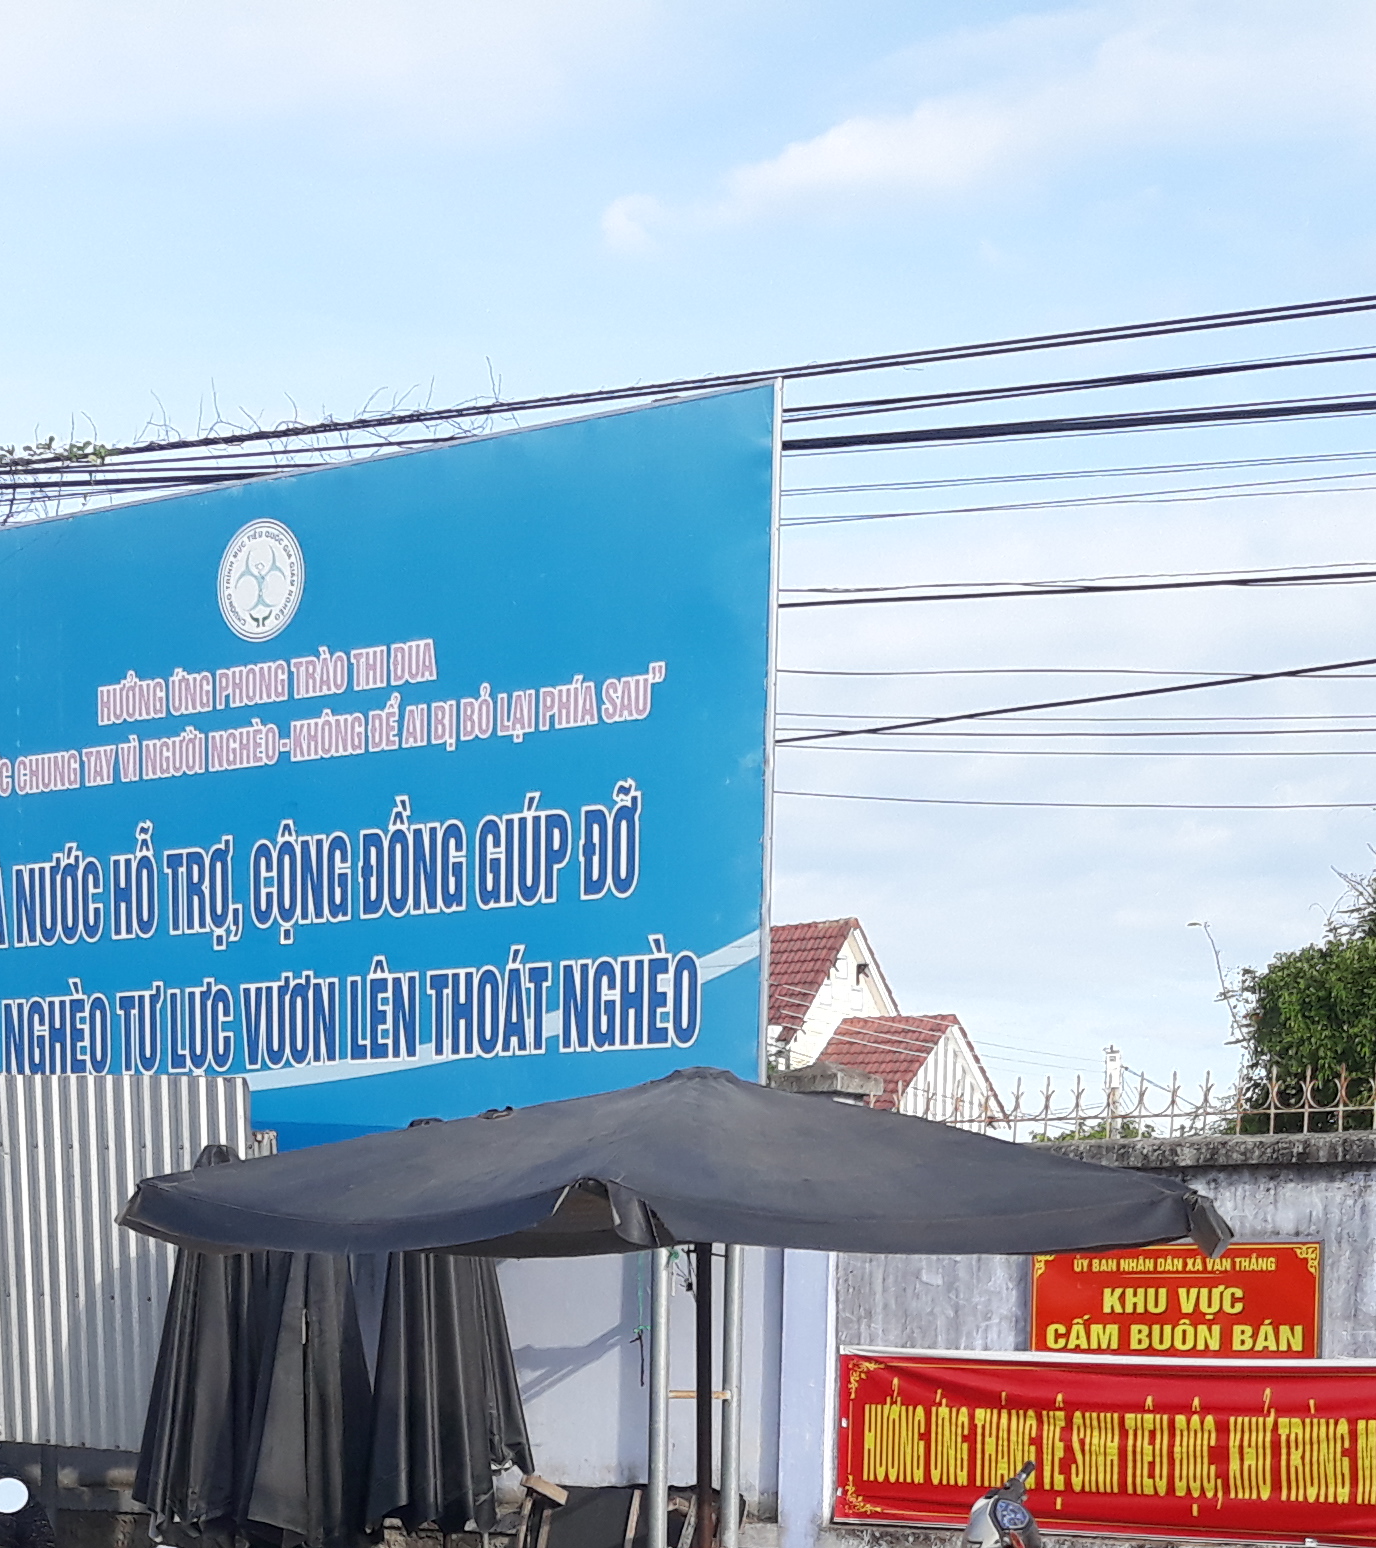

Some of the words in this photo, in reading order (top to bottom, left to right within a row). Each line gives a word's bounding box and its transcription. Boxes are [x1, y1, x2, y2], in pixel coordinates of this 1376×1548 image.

[98, 670, 166, 726] HƯỞNG
[169, 667, 212, 716] ỨNG
[216, 660, 288, 710] PHONG
[291, 646, 347, 700] TRÀO
[351, 645, 387, 691] THI
[391, 639, 437, 686] ĐUA
[15, 749, 79, 795] CHUNG
[83, 745, 116, 786] TAY
[119, 735, 139, 782] VÌ
[143, 726, 205, 780] NGƯỜI
[368, 692, 401, 752] ĐỂ
[402, 702, 427, 748] AI
[431, 700, 456, 751] BỊ
[461, 682, 493, 741] BỎ
[497, 690, 535, 743] LẠI
[539, 675, 598, 731] PHÍA
[12, 842, 103, 948] NƯỚC
[110, 819, 158, 940] HỖ
[164, 835, 242, 950] TRỢ,
[250, 819, 351, 944] CỘNG
[358, 794, 467, 919] ĐỒNG
[476, 791, 571, 910] GIÚP
[579, 778, 642, 900] ĐỠ
[1, 977, 111, 1075] NGHÈO
[116, 980, 164, 1075] TƯ
[240, 971, 338, 1069] VƯƠN
[347, 955, 419, 1062] LÊN
[427, 945, 551, 1059] THOÁT
[559, 934, 701, 1053] NGHÈO
[1091, 1258, 1116, 1272] BAN
[1120, 1255, 1154, 1272] NHÂN
[1157, 1255, 1182, 1271] DÂN
[1185, 1255, 1203, 1271] XÃ
[1206, 1258, 1230, 1274] VẠN
[1234, 1253, 1276, 1271] THẮNG
[1103, 1287, 1167, 1314] KHU
[1178, 1285, 1244, 1319] VỰC
[1046, 1315, 1119, 1350] CẤM
[1129, 1319, 1220, 1351] BUÔN
[1232, 1319, 1304, 1352] BÁN
[862, 1377, 925, 1484] HƯỞNG
[930, 1388, 969, 1487] ỨNG
[974, 1391, 1037, 1490] THÁNG
[1042, 1392, 1066, 1510] VỆ
[1070, 1411, 1119, 1494] SINH
[1124, 1395, 1169, 1497] TIÊU
[1174, 1396, 1223, 1517] ĐỘC,
[1229, 1386, 1276, 1501] KHỬ
[1278, 1398, 1350, 1505] TRÙNG
